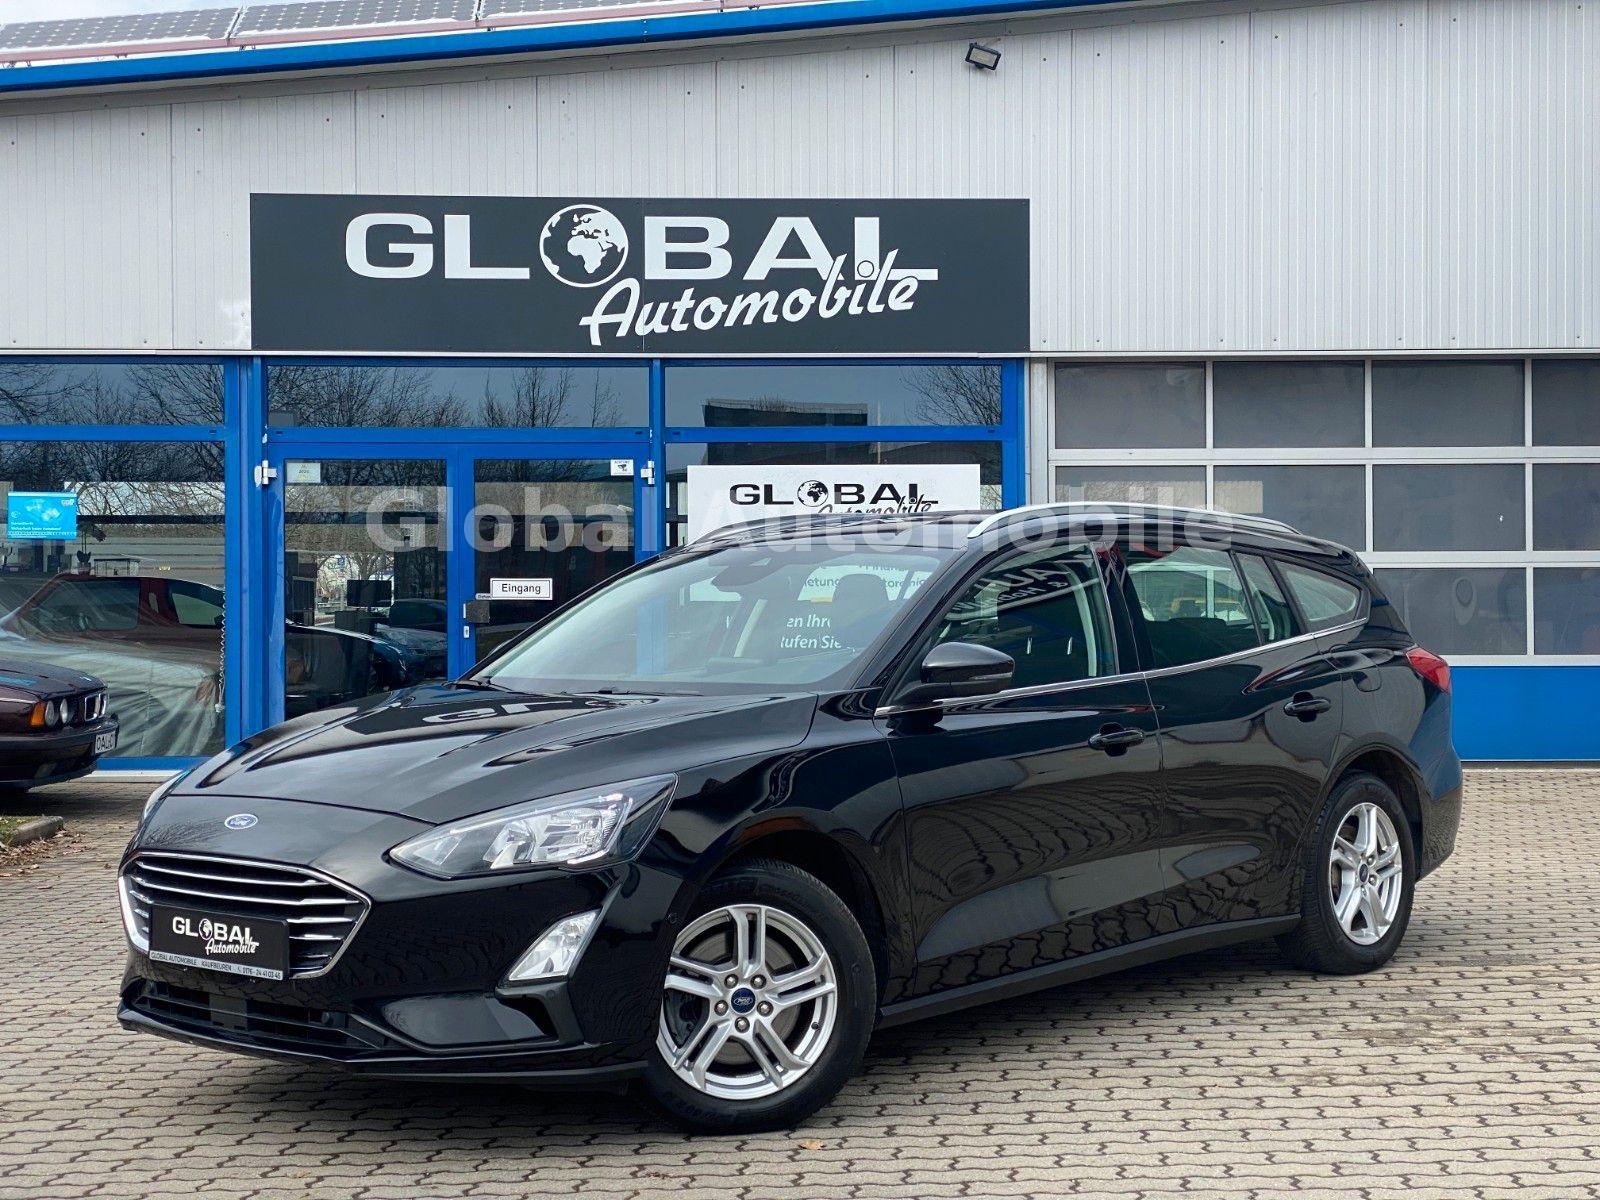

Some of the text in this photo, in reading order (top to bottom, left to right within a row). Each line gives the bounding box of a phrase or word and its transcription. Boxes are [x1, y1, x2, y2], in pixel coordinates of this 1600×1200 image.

[345, 204, 938, 287] GLOBAL
[579, 249, 918, 345] Automobile
[729, 480, 938, 507] GLOBAL
[501, 583, 541, 595] Eingang
[172, 916, 259, 946] GLOBAL
[150, 951, 168, 961] GLOBAL
[168, 955, 198, 966] AUTOMOBILE
[205, 936, 257, 956] Automobile
